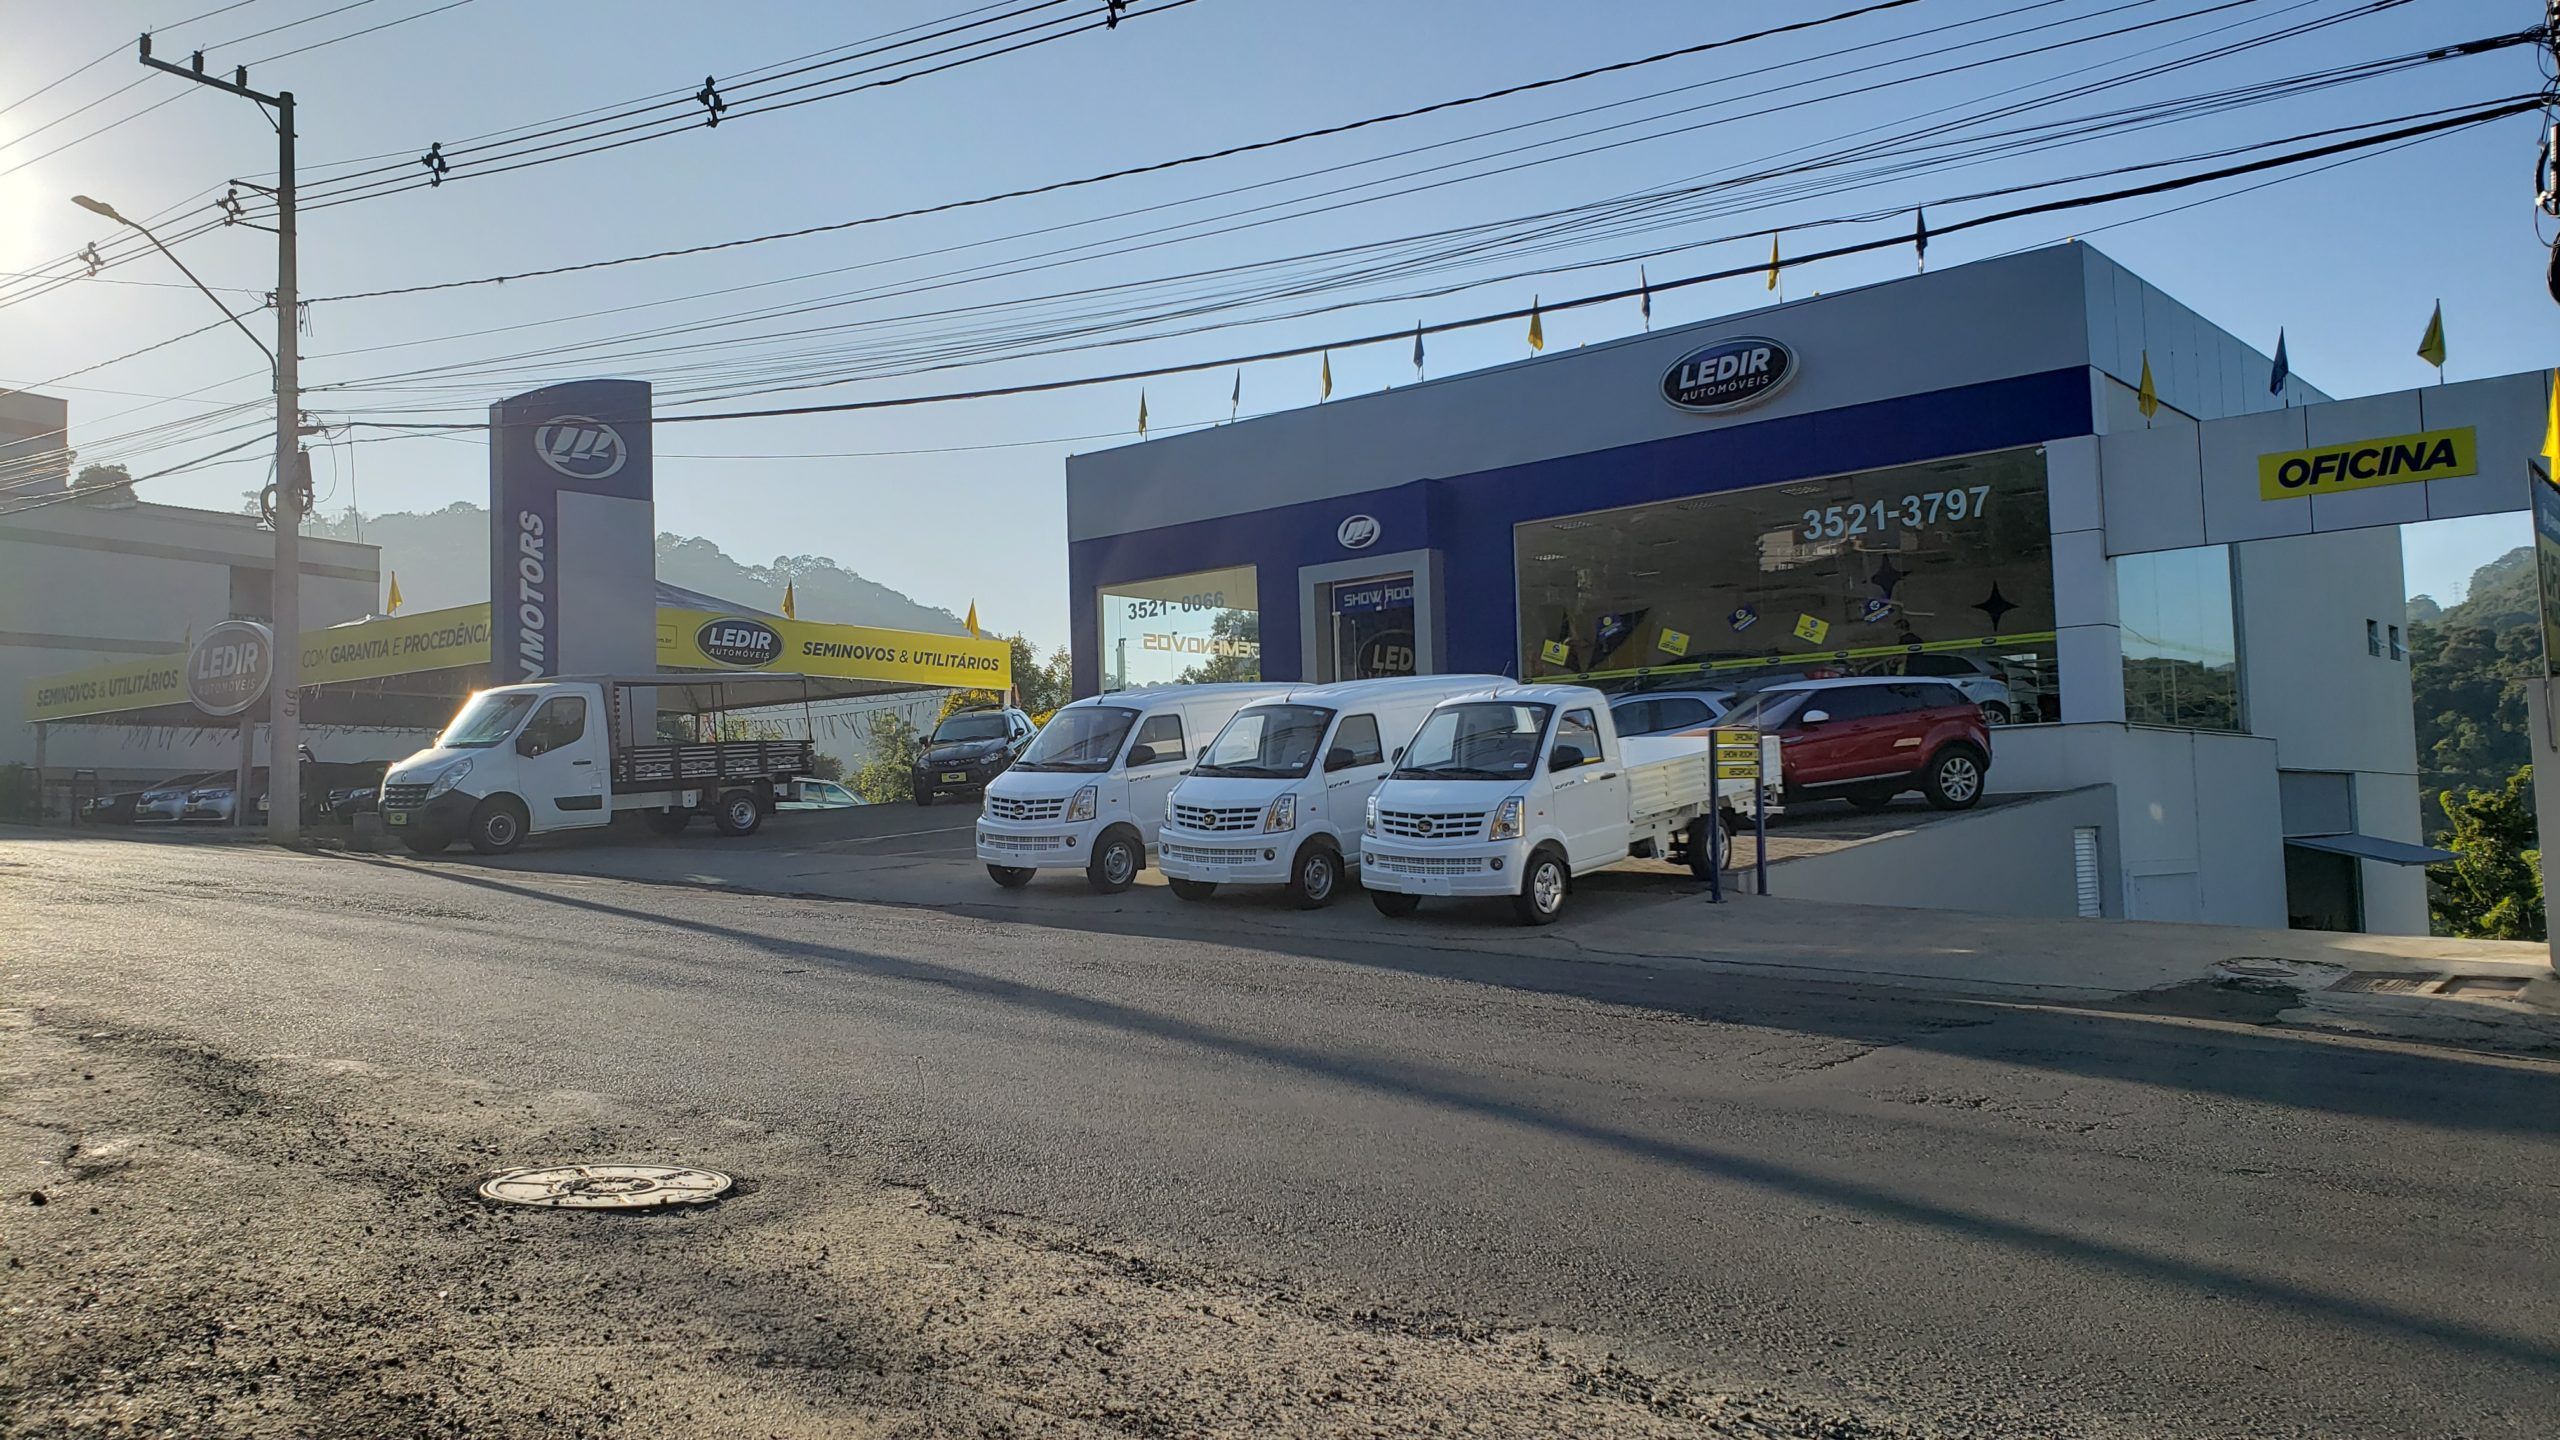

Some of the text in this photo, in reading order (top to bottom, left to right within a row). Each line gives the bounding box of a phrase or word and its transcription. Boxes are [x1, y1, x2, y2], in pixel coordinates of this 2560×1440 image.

[1679, 347, 1771, 390] LEDIR
[1680, 374, 1770, 402] AUTOMÓVEIS
[2278, 438, 2457, 488] OFICINA
[1802, 485, 1991, 540] 3521-3797
[1343, 586, 1414, 607] SHOW ROO
[330, 639, 390, 664] GARANTIA
[393, 637, 403, 656] E
[708, 627, 772, 650] LEDIR
[709, 647, 770, 659] AUTOMÓVEIS
[198, 642, 259, 680] LEDIR
[802, 641, 1000, 672] SEMINOVOS & UTILITÁRIOS
[1372, 643, 1414, 672] LED
[37, 681, 97, 708] SEMINOVOS
[108, 668, 179, 698] UTILITÁRIOS
[198, 679, 257, 697] AUTOMÓVEIS
